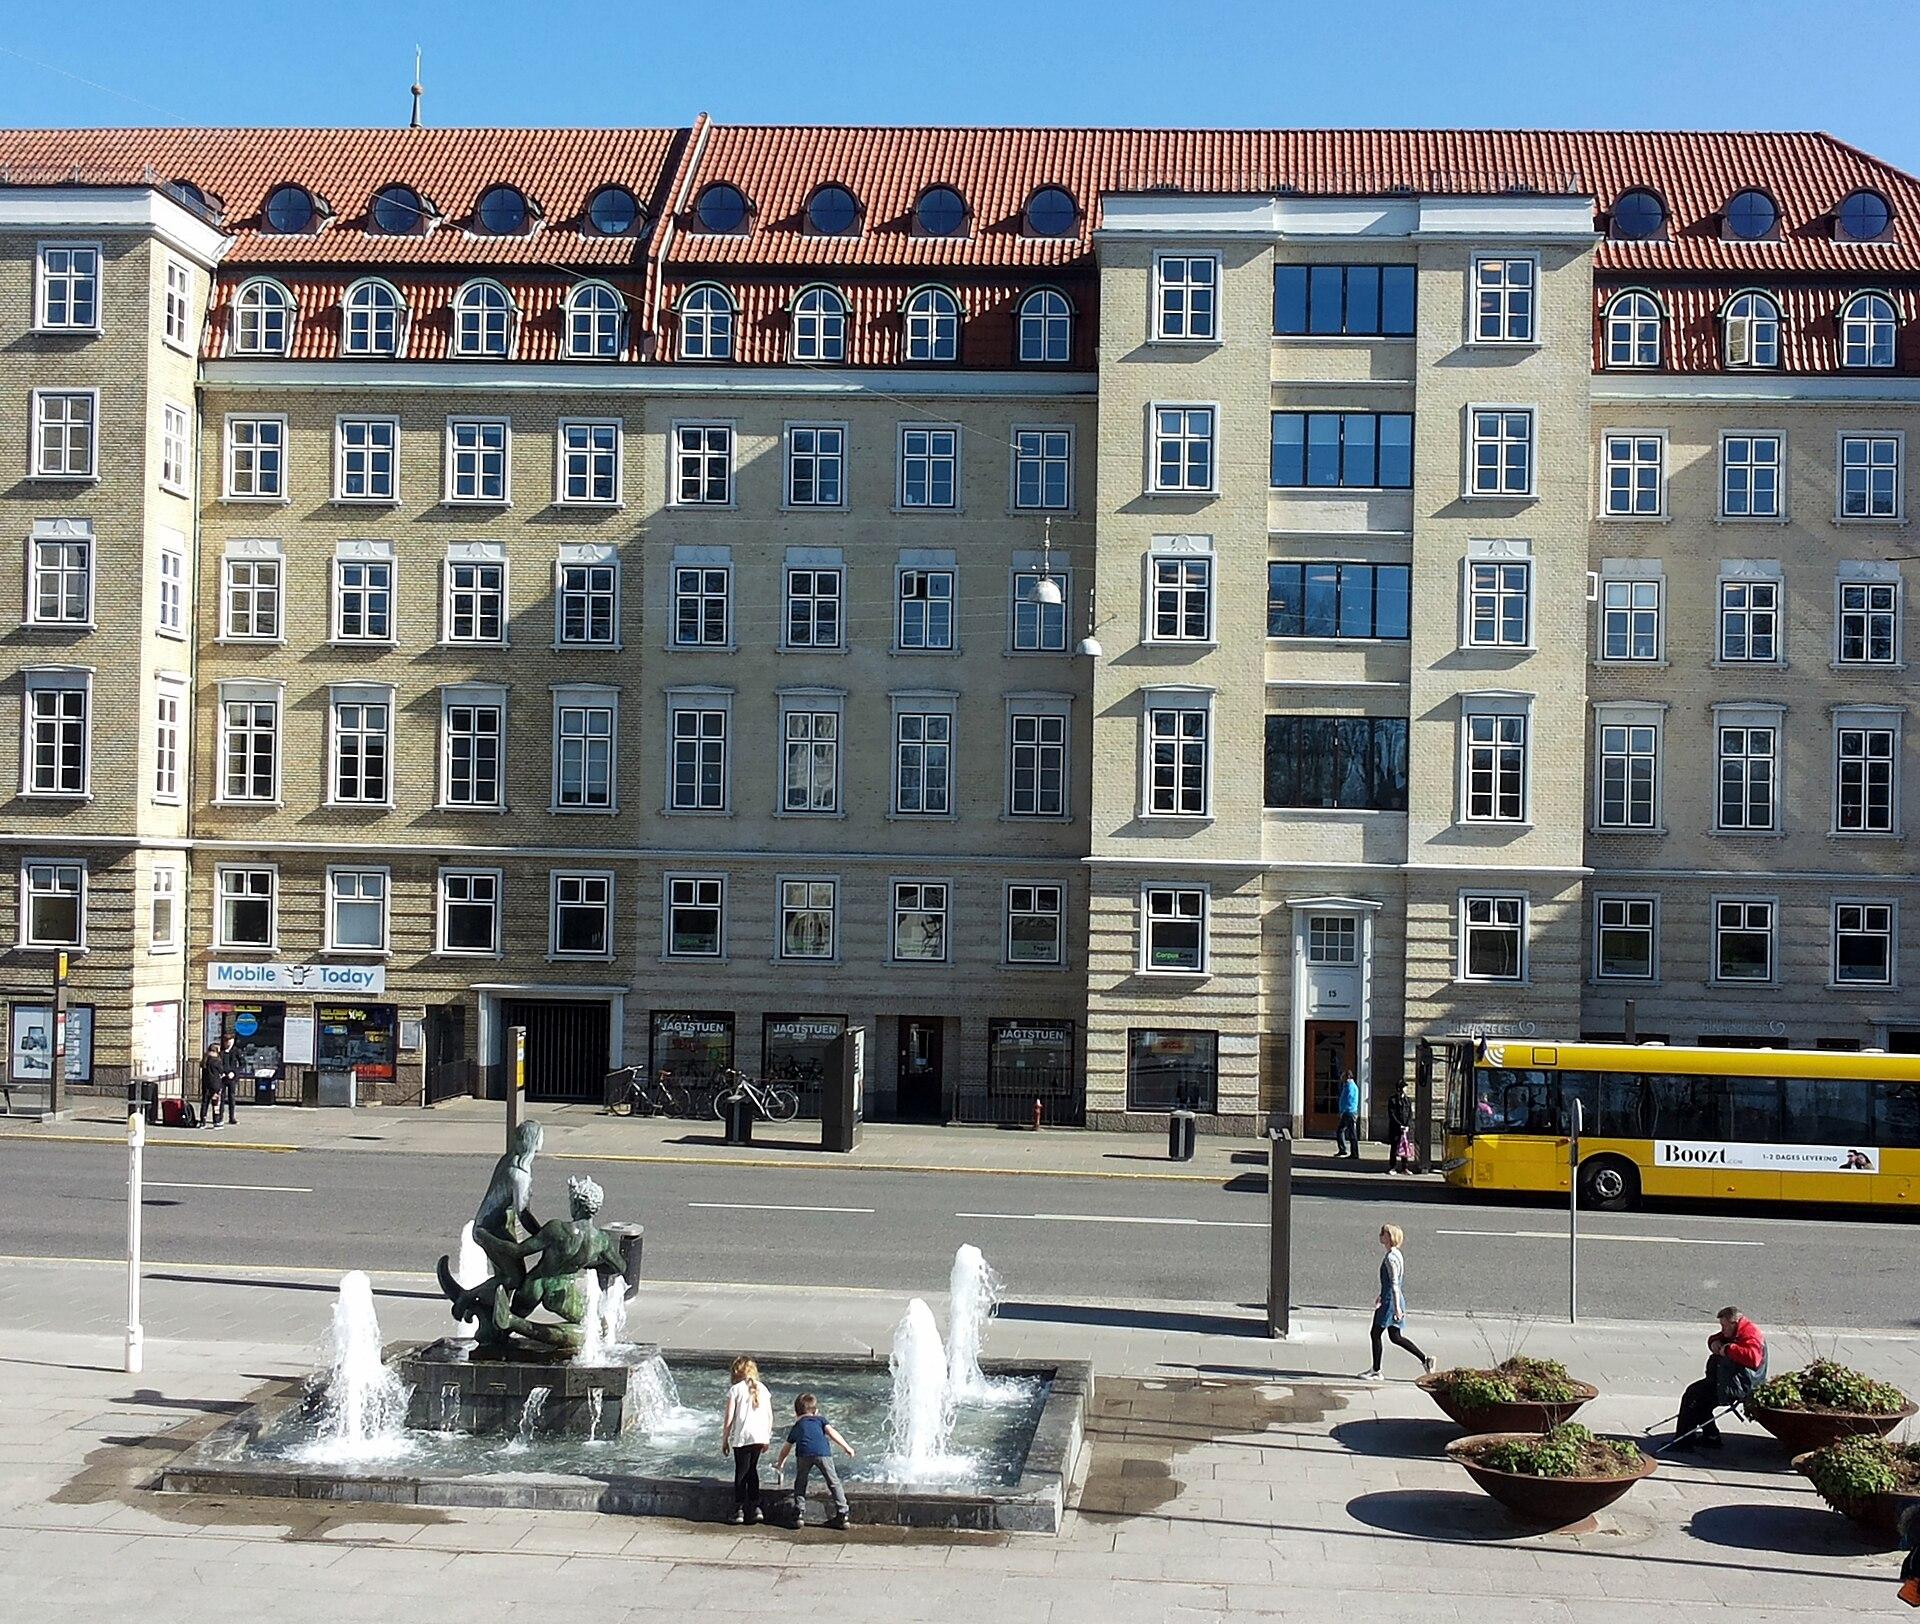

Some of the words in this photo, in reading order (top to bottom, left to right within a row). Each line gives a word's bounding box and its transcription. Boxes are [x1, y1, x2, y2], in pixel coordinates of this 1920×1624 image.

[217, 965, 276, 981] Mobile
[320, 967, 374, 987] Today
[661, 1022, 724, 1032] JAGTSTUEN
[773, 1024, 837, 1034] JAGTSTUEN
[1000, 1029, 1064, 1040] JAGTSTUEN
